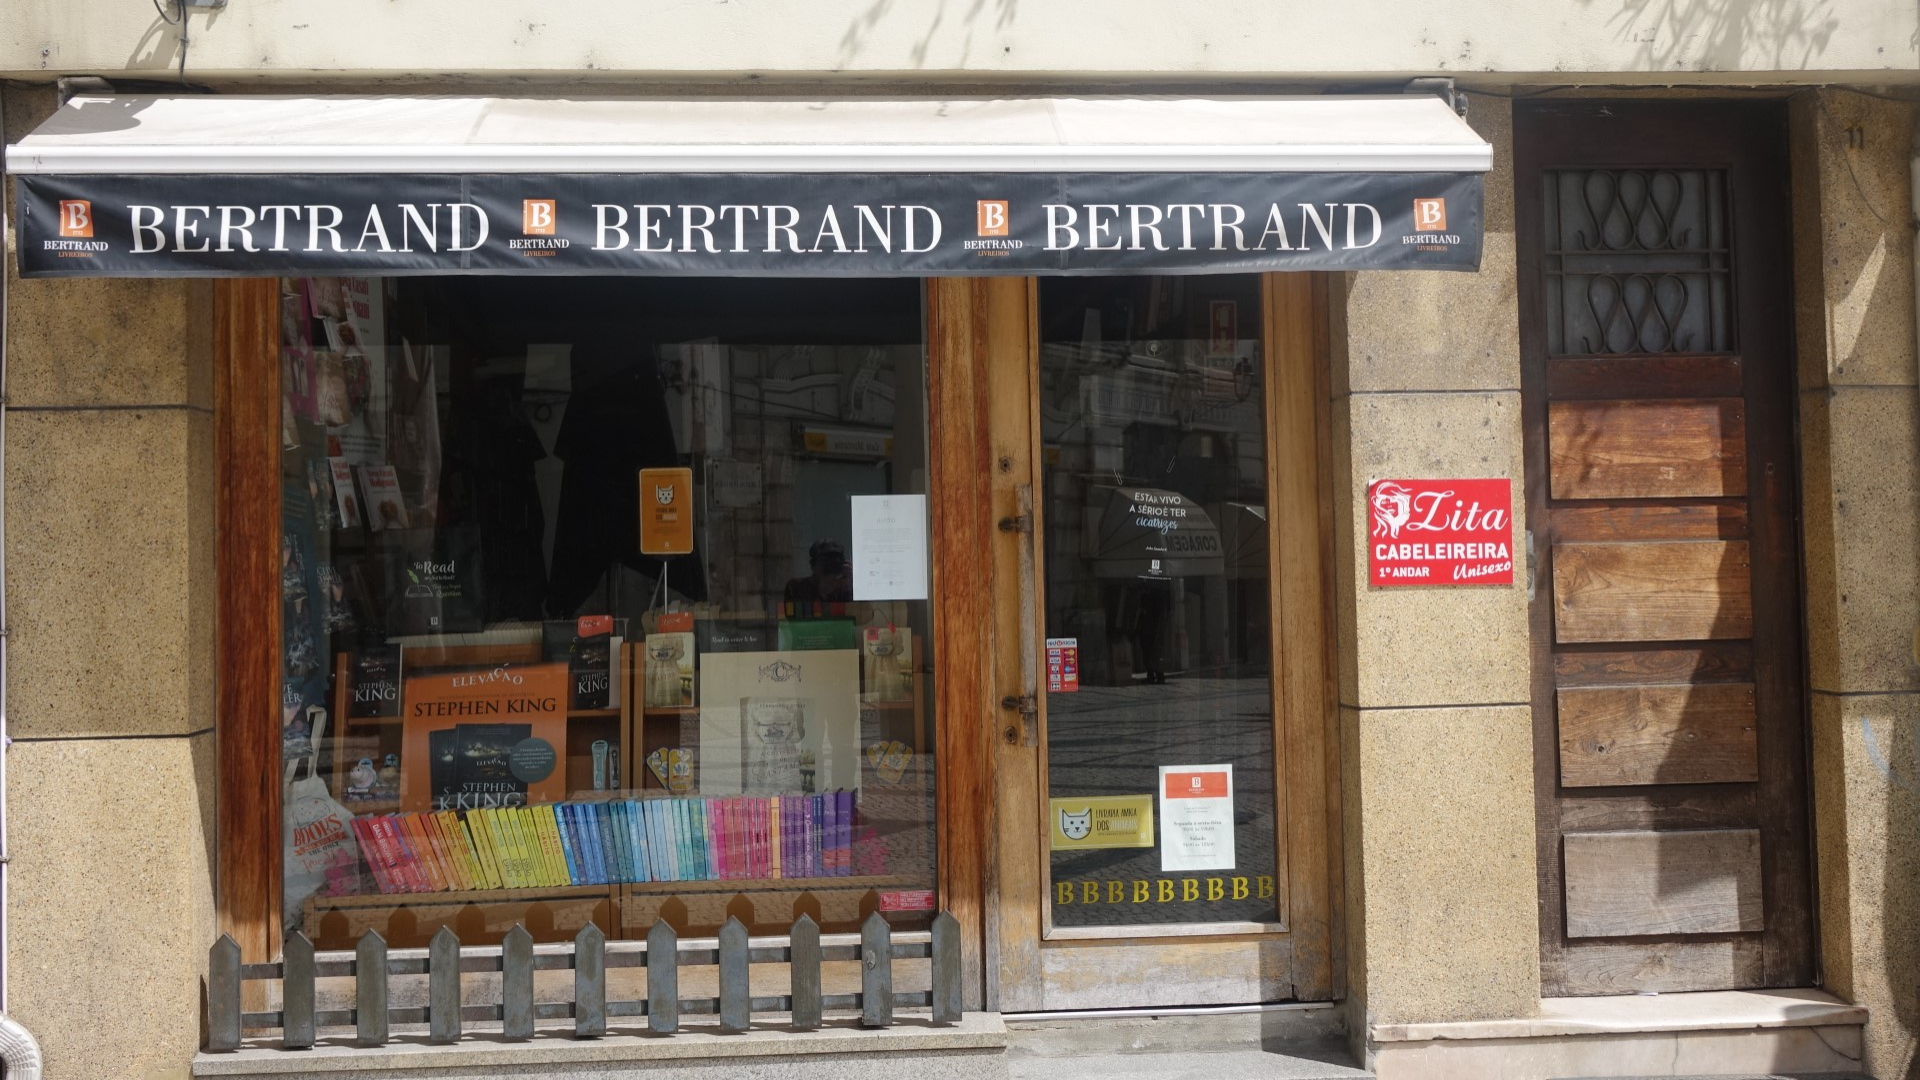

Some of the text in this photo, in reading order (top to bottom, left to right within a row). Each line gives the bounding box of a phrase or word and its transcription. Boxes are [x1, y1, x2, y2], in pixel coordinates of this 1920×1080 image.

[1844, 126, 1865, 150] 11
[530, 202, 552, 228] B
[983, 203, 1005, 229] B
[1420, 201, 1442, 224] B
[127, 203, 490, 254] BERTRAND
[591, 204, 942, 254] BERTRAND
[1041, 203, 1383, 252] BERTRAND
[43, 240, 109, 252] BERTRAND
[509, 238, 570, 249] BERTRAND
[963, 240, 1023, 250] BERTRAND
[1402, 234, 1461, 245] BERTRAND
[1134, 492, 1181, 505] ESTAR VIVO
[1129, 504, 1136, 513] A
[1137, 504, 1163, 516] SÉRIO
[1163, 507, 1169, 517] É
[1170, 508, 1187, 518] TER
[1406, 490, 1508, 532] Zita
[1135, 517, 1179, 535] cicatrizes
[1375, 543, 1509, 560] CABELEIREIRA
[413, 560, 455, 575] To Read
[1379, 566, 1430, 577] 1º ANDAR
[1453, 560, 1511, 580] Unisexo
[452, 662, 524, 687] ELEVAÇÃO
[581, 672, 606, 682] STEPHEN
[358, 680, 393, 689] STEPHEN
[578, 677, 608, 694] KING
[355, 688, 396, 702] KING
[414, 697, 557, 717] STEPHEN KING
[462, 782, 516, 792] STEPHEN
[456, 792, 521, 809] KING
[1095, 807, 1138, 819] LIVRARIA AMIGA
[293, 813, 343, 847] BOOKS
[1096, 819, 1110, 831] DOS
[372, 823, 395, 864] DAN BROWN
